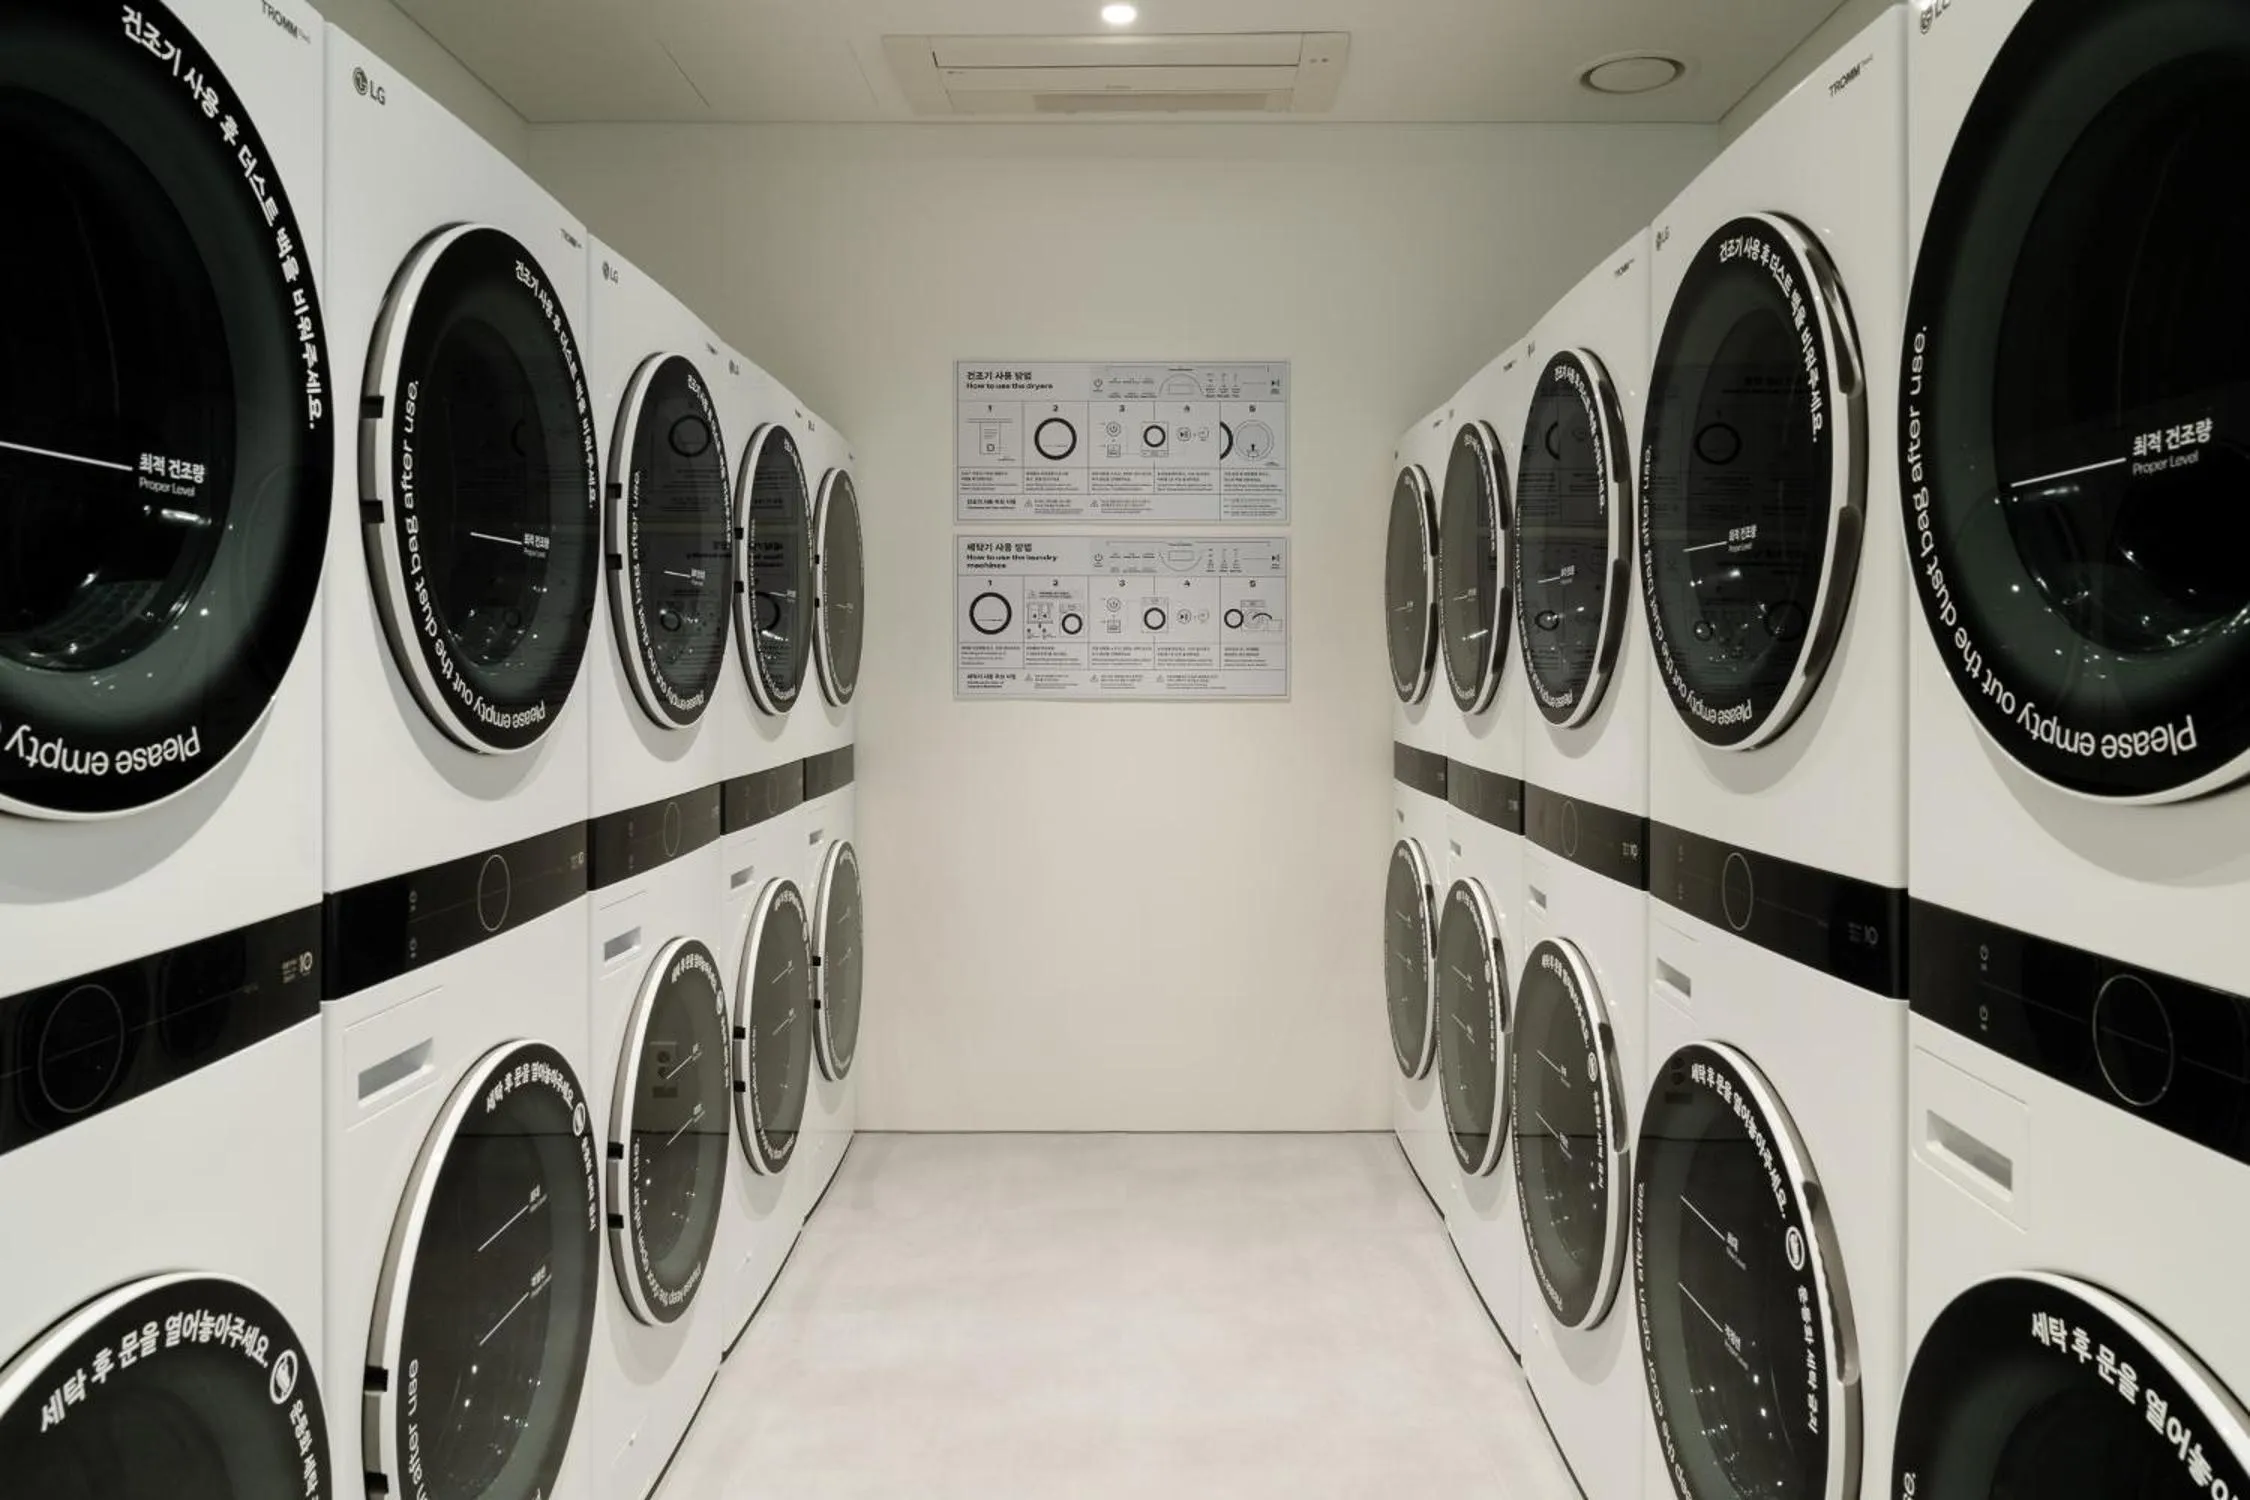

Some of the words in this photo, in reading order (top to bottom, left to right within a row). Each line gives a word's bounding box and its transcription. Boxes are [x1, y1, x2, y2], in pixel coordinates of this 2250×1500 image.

[122, 5, 182, 77] 건조기
[184, 67, 219, 118] 사용
[220, 115, 239, 146] 후
[238, 145, 279, 227] 더스트
[277, 227, 299, 283] 백을
[292, 288, 323, 429] 비워주세요.
[516, 260, 539, 297] 건조기
[1720, 235, 1744, 263] 건조기
[1744, 237, 1761, 261] 사용
[1769, 254, 1793, 298] 더스트
[1801, 327, 1823, 443] 비워주세요.
[1910, 325, 1928, 396] use.
[404, 380, 419, 433] use.
[1907, 405, 1923, 482] after
[2132, 429, 2161, 456] 최적
[2165, 417, 2213, 451] 건조량
[139, 453, 166, 476] 최적
[168, 459, 205, 484] 건조량
[400, 438, 413, 509] after
[405, 515, 422, 575] bag
[1912, 486, 1934, 558] bag
[415, 577, 437, 638] dust
[1926, 554, 1957, 626] dust
[435, 638, 454, 679] the
[1954, 627, 1982, 679] the
[452, 672, 474, 706] out
[473, 695, 511, 729] empty
[512, 700, 546, 729] Please
[1686, 690, 1717, 725] empty
[1717, 698, 1753, 726] Please
[1981, 669, 2016, 714] out
[4, 724, 109, 776] empty
[115, 725, 201, 774] Please
[2017, 702, 2095, 756] empty
[2101, 714, 2198, 759] Please
[1635, 1225, 1645, 1282] after
[1640, 1287, 1652, 1352] open
[40, 1368, 87, 1432] 세탁
[91, 1346, 115, 1384] 후
[118, 1320, 160, 1368] 문을
[164, 1309, 270, 1368] 열어놓아주세요.
[2032, 1312, 2067, 1353] 세탁
[2071, 1326, 2092, 1363] 후
[2096, 1343, 2139, 1404] 문을
[1648, 1358, 1663, 1417] door
[289, 1400, 313, 1456] 운동화
